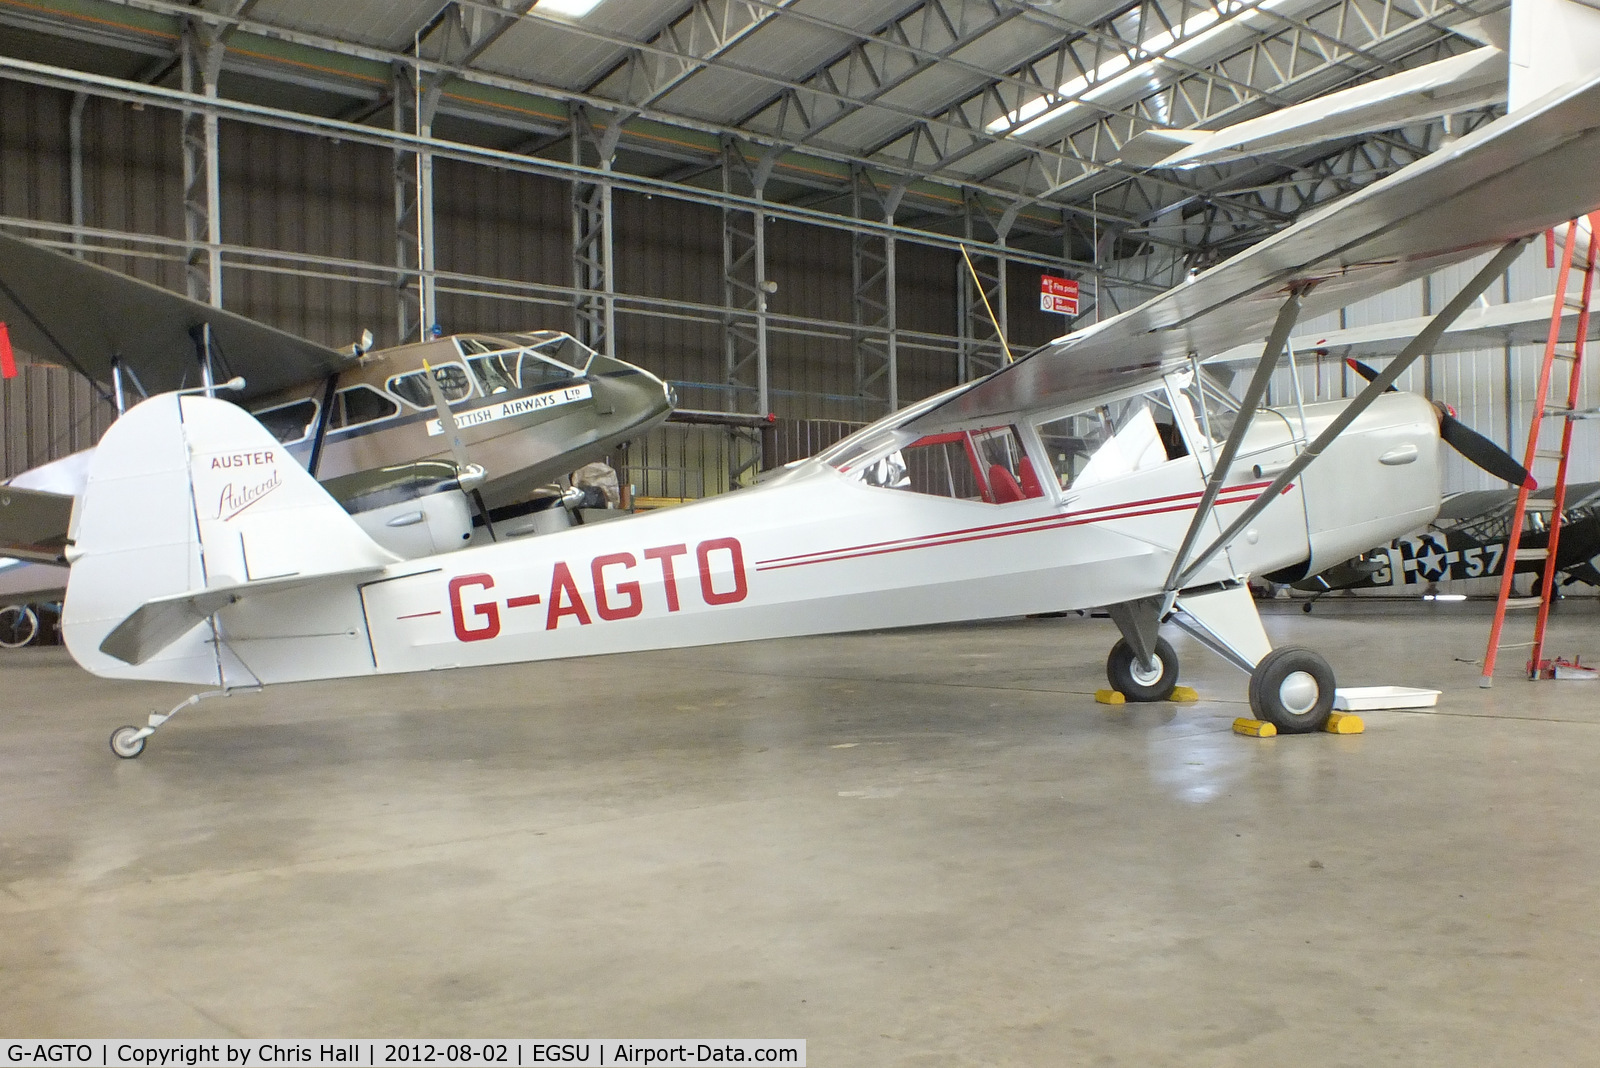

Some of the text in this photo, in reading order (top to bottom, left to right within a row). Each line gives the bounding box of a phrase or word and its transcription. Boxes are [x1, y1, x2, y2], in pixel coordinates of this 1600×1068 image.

[1053, 282, 1064, 291] Fire
[436, 409, 492, 432] SOTTISH
[502, 394, 556, 416] AIRWAYS
[211, 451, 274, 469] AUSTER
[211, 469, 282, 521] Autocrat
[1463, 543, 1504, 577] 57
[448, 536, 748, 643] G-AGTO
